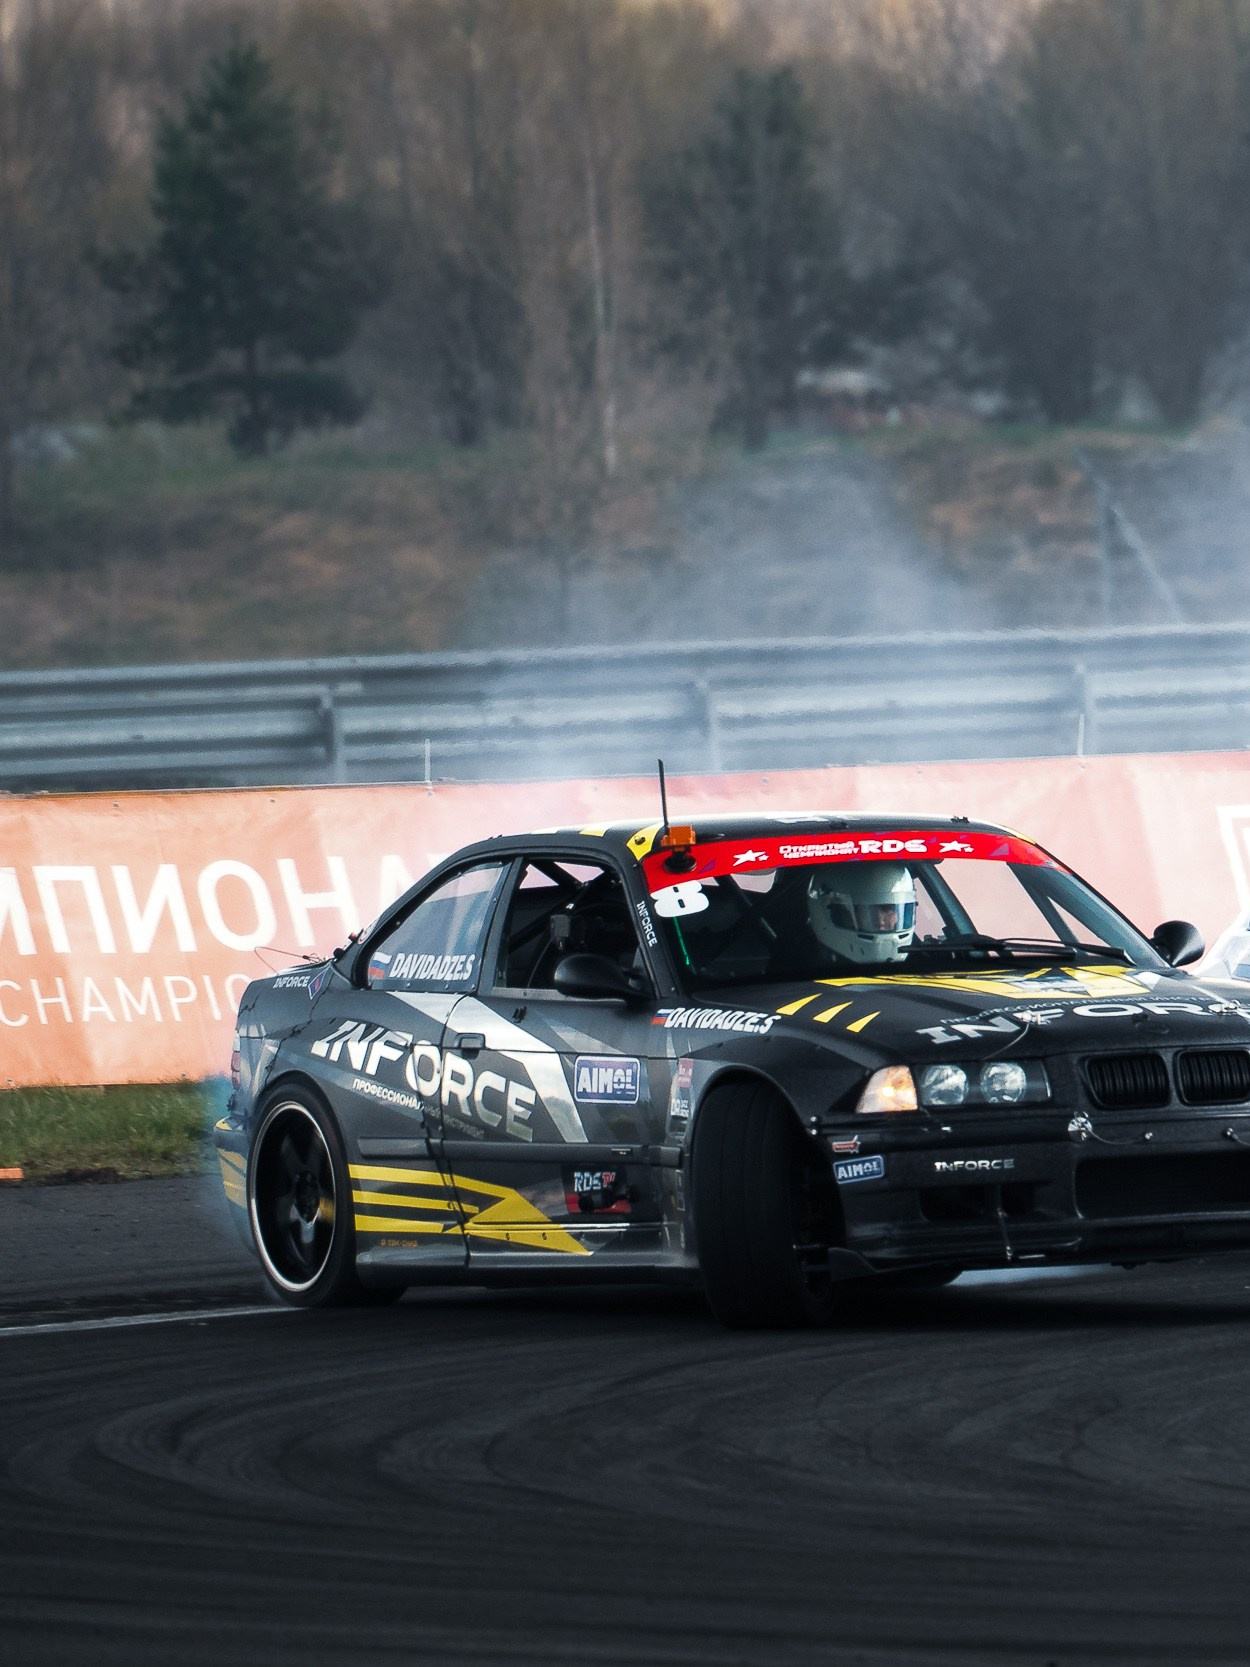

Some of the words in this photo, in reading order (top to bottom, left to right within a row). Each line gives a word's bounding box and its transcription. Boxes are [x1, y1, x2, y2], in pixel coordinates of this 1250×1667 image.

[858, 839, 927, 853] RDS
[636, 900, 658, 948] INFORCE
[273, 975, 310, 989] INFORCE
[311, 1020, 536, 1142] INFORCE
[577, 1066, 637, 1094] AIMOL
[838, 1160, 879, 1179] AIMOL
[934, 1158, 1015, 1172] INFORCE
